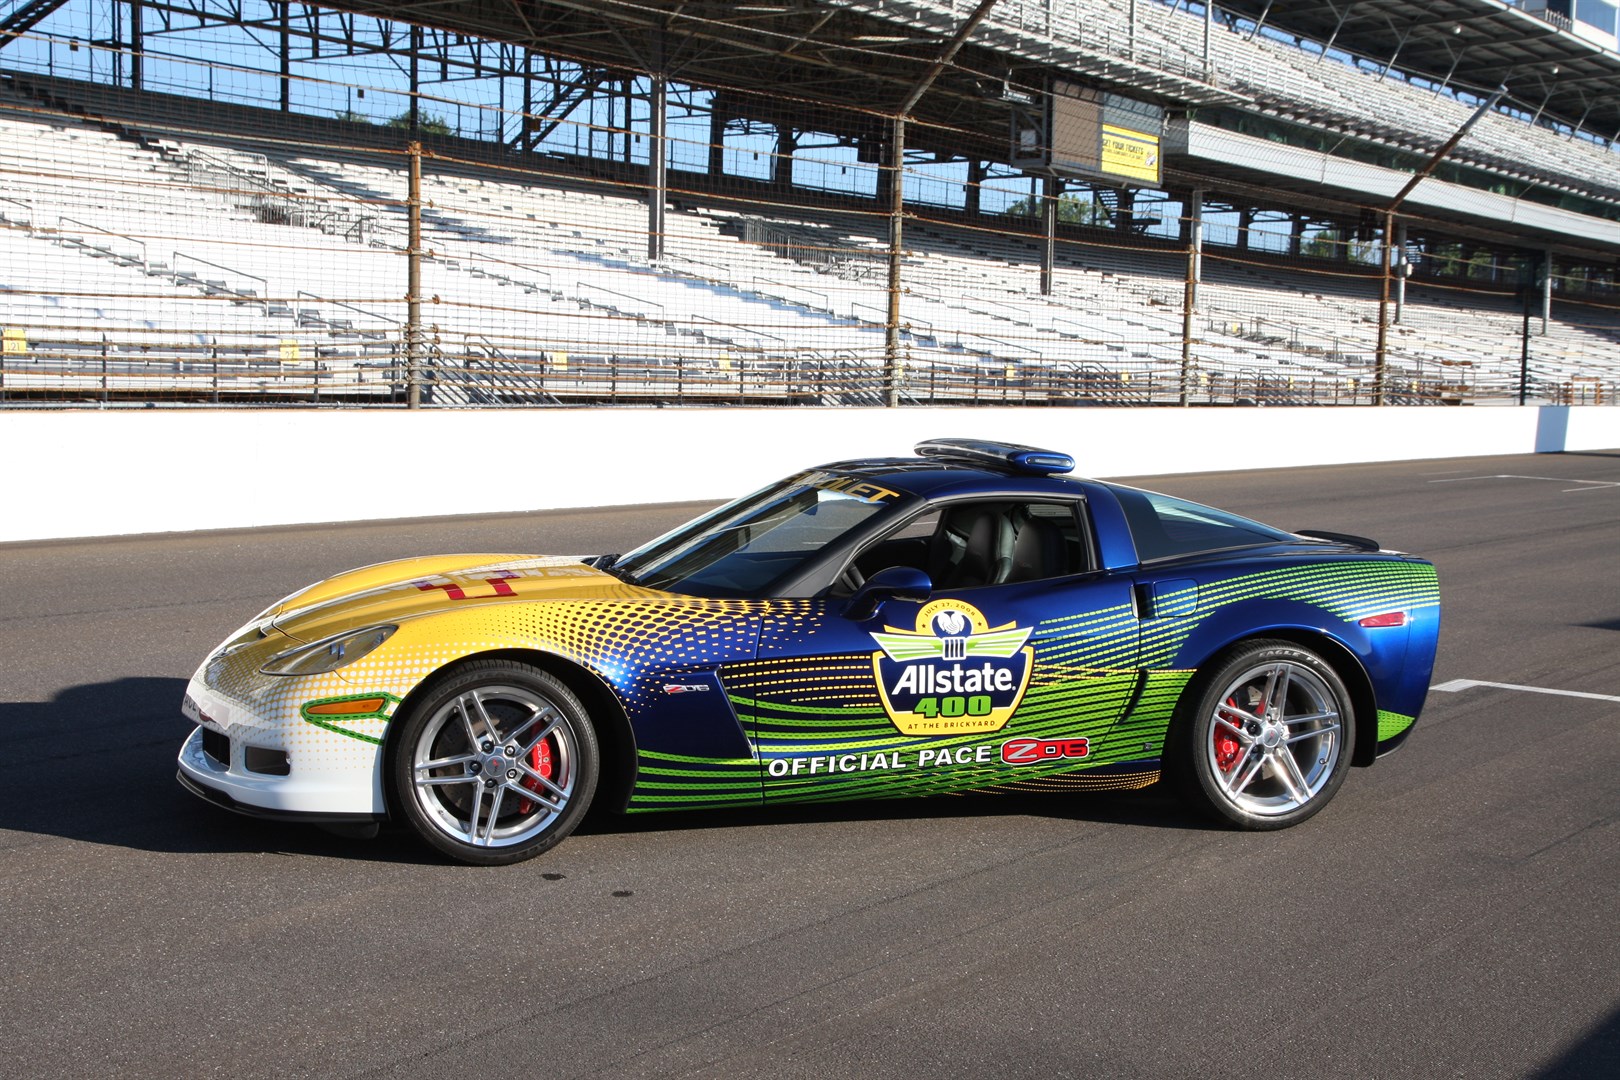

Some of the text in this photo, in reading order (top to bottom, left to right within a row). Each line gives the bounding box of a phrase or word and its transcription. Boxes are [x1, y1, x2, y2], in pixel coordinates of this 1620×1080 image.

[924, 604, 938, 617] JULY
[1259, 650, 1300, 658] EAGLE
[891, 662, 1014, 695] Allstate
[913, 695, 992, 718] 400
[943, 720, 996, 729] BRICKYARD
[768, 737, 1090, 777] OFFICIAL PACE Z06
